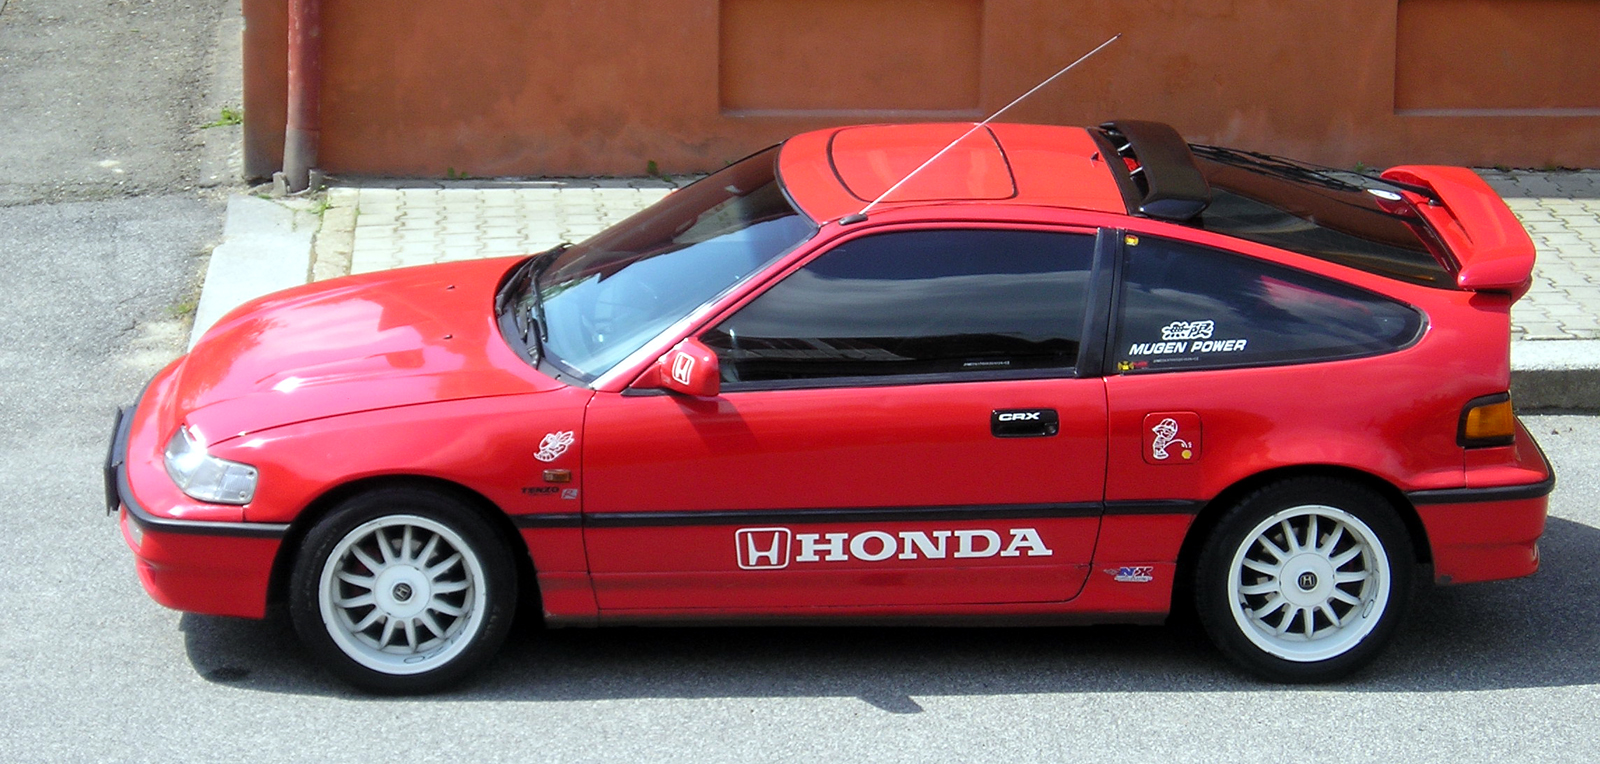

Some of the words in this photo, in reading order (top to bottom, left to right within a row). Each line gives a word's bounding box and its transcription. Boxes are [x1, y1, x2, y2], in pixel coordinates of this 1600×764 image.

[1129, 342, 1187, 355] MUGEN
[1190, 339, 1247, 353] POWER
[998, 412, 1040, 421] CRX
[796, 528, 1053, 562] HONDA
